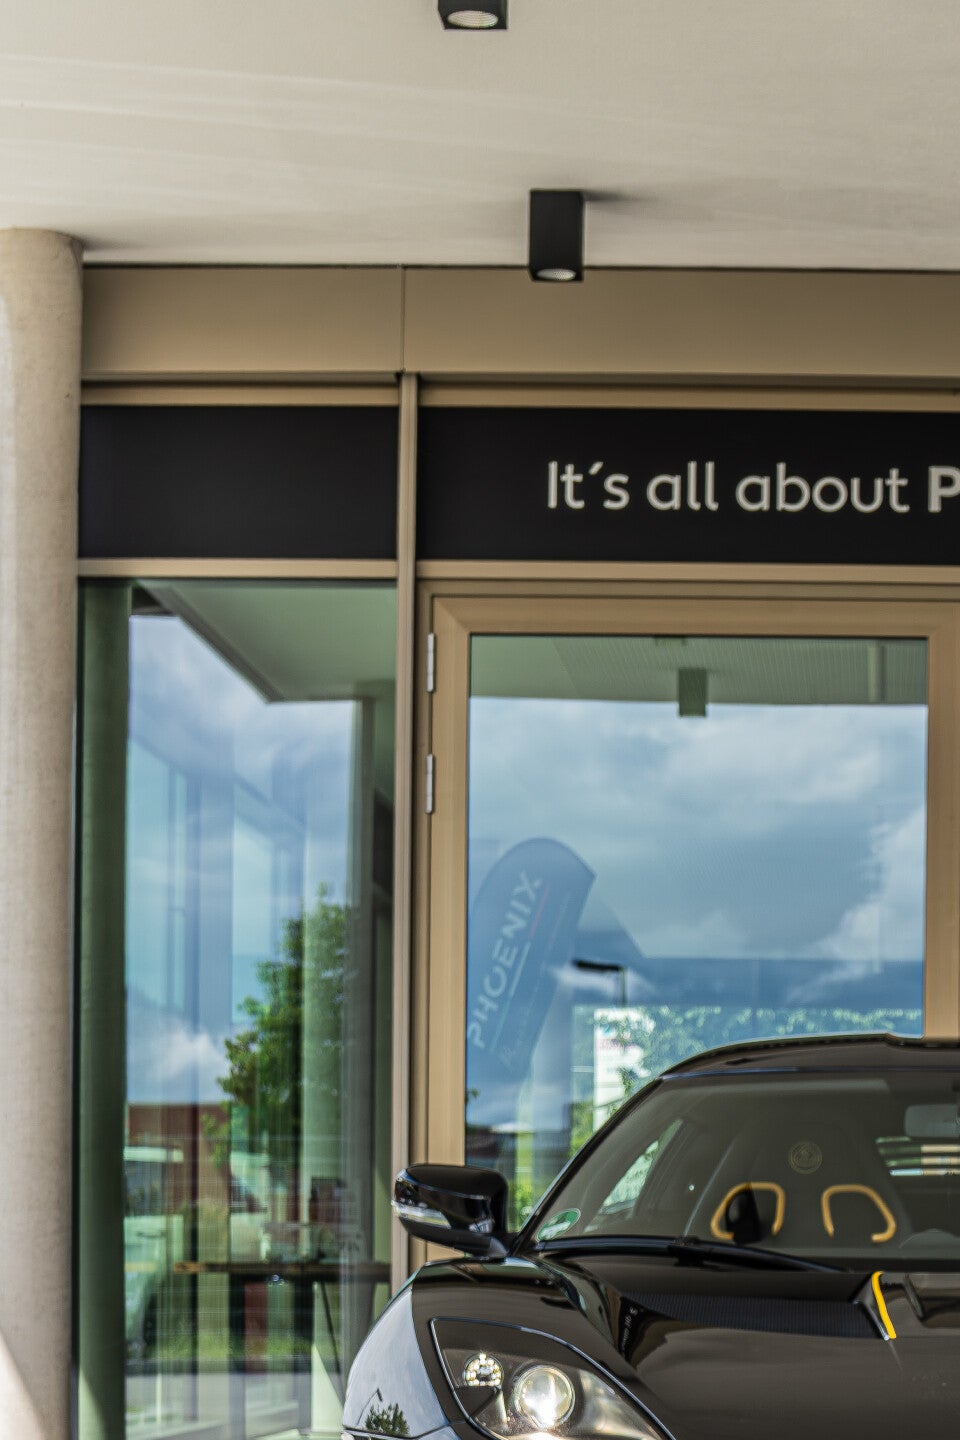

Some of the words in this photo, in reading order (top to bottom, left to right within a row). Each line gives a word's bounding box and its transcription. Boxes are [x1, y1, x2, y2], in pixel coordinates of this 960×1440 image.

[646, 461, 719, 513] all
[735, 462, 910, 516] about
[467, 871, 541, 1048] PHOENIX
